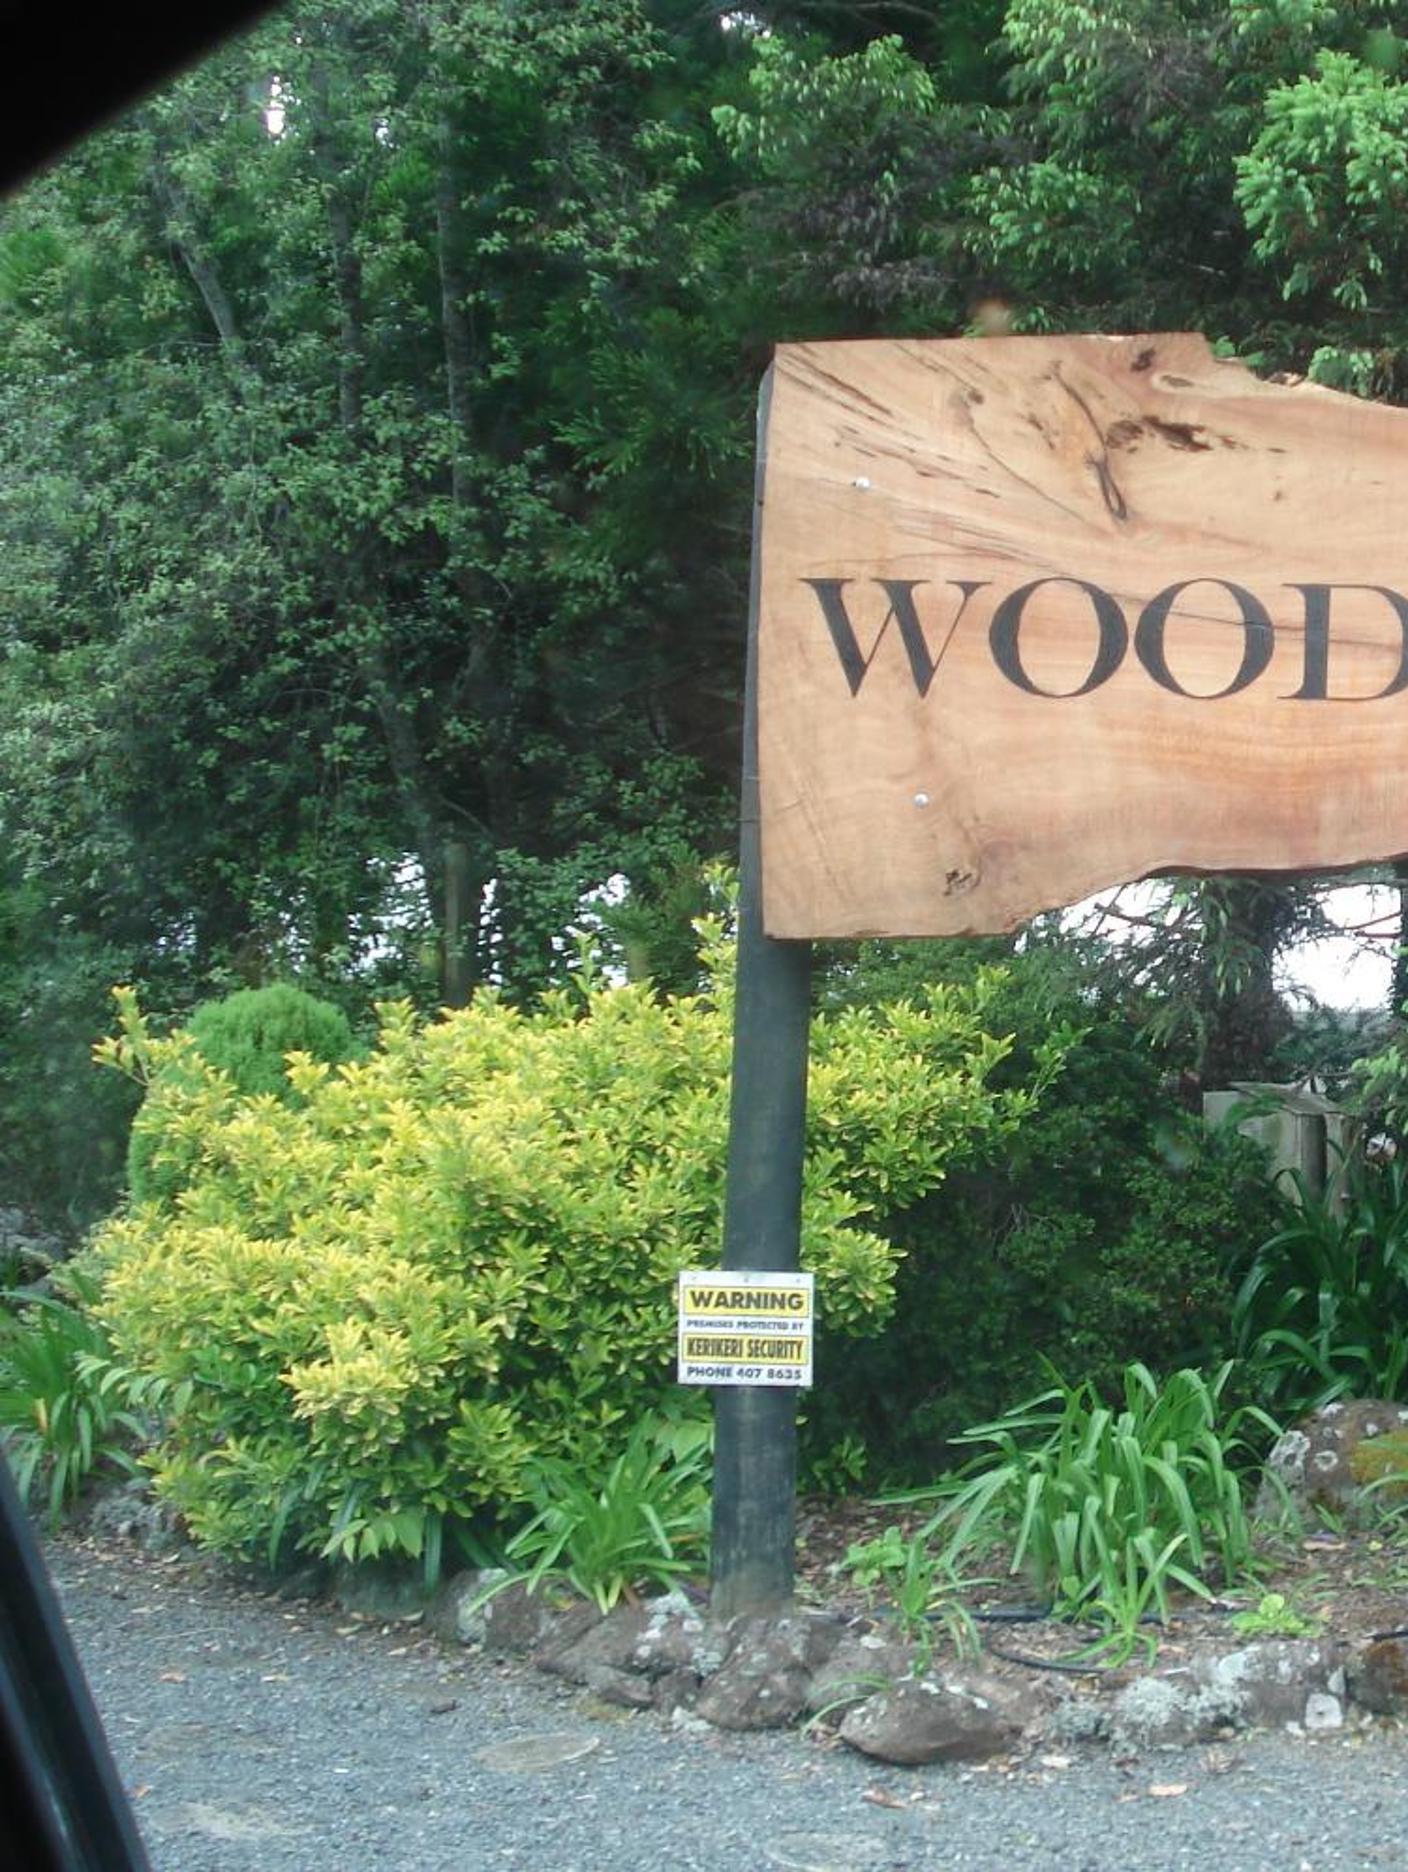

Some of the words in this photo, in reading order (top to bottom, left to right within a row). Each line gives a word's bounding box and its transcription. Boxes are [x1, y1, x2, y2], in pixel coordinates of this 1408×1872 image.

[690, 1291, 804, 1309] WARNING
[687, 1320, 733, 1328] PREMISES
[736, 1321, 789, 1329] PROTECTED
[687, 1338, 743, 1358] KERIKERI
[747, 1340, 803, 1360] SECURITY
[687, 1367, 733, 1378] PHONE
[736, 1368, 761, 1378] 407
